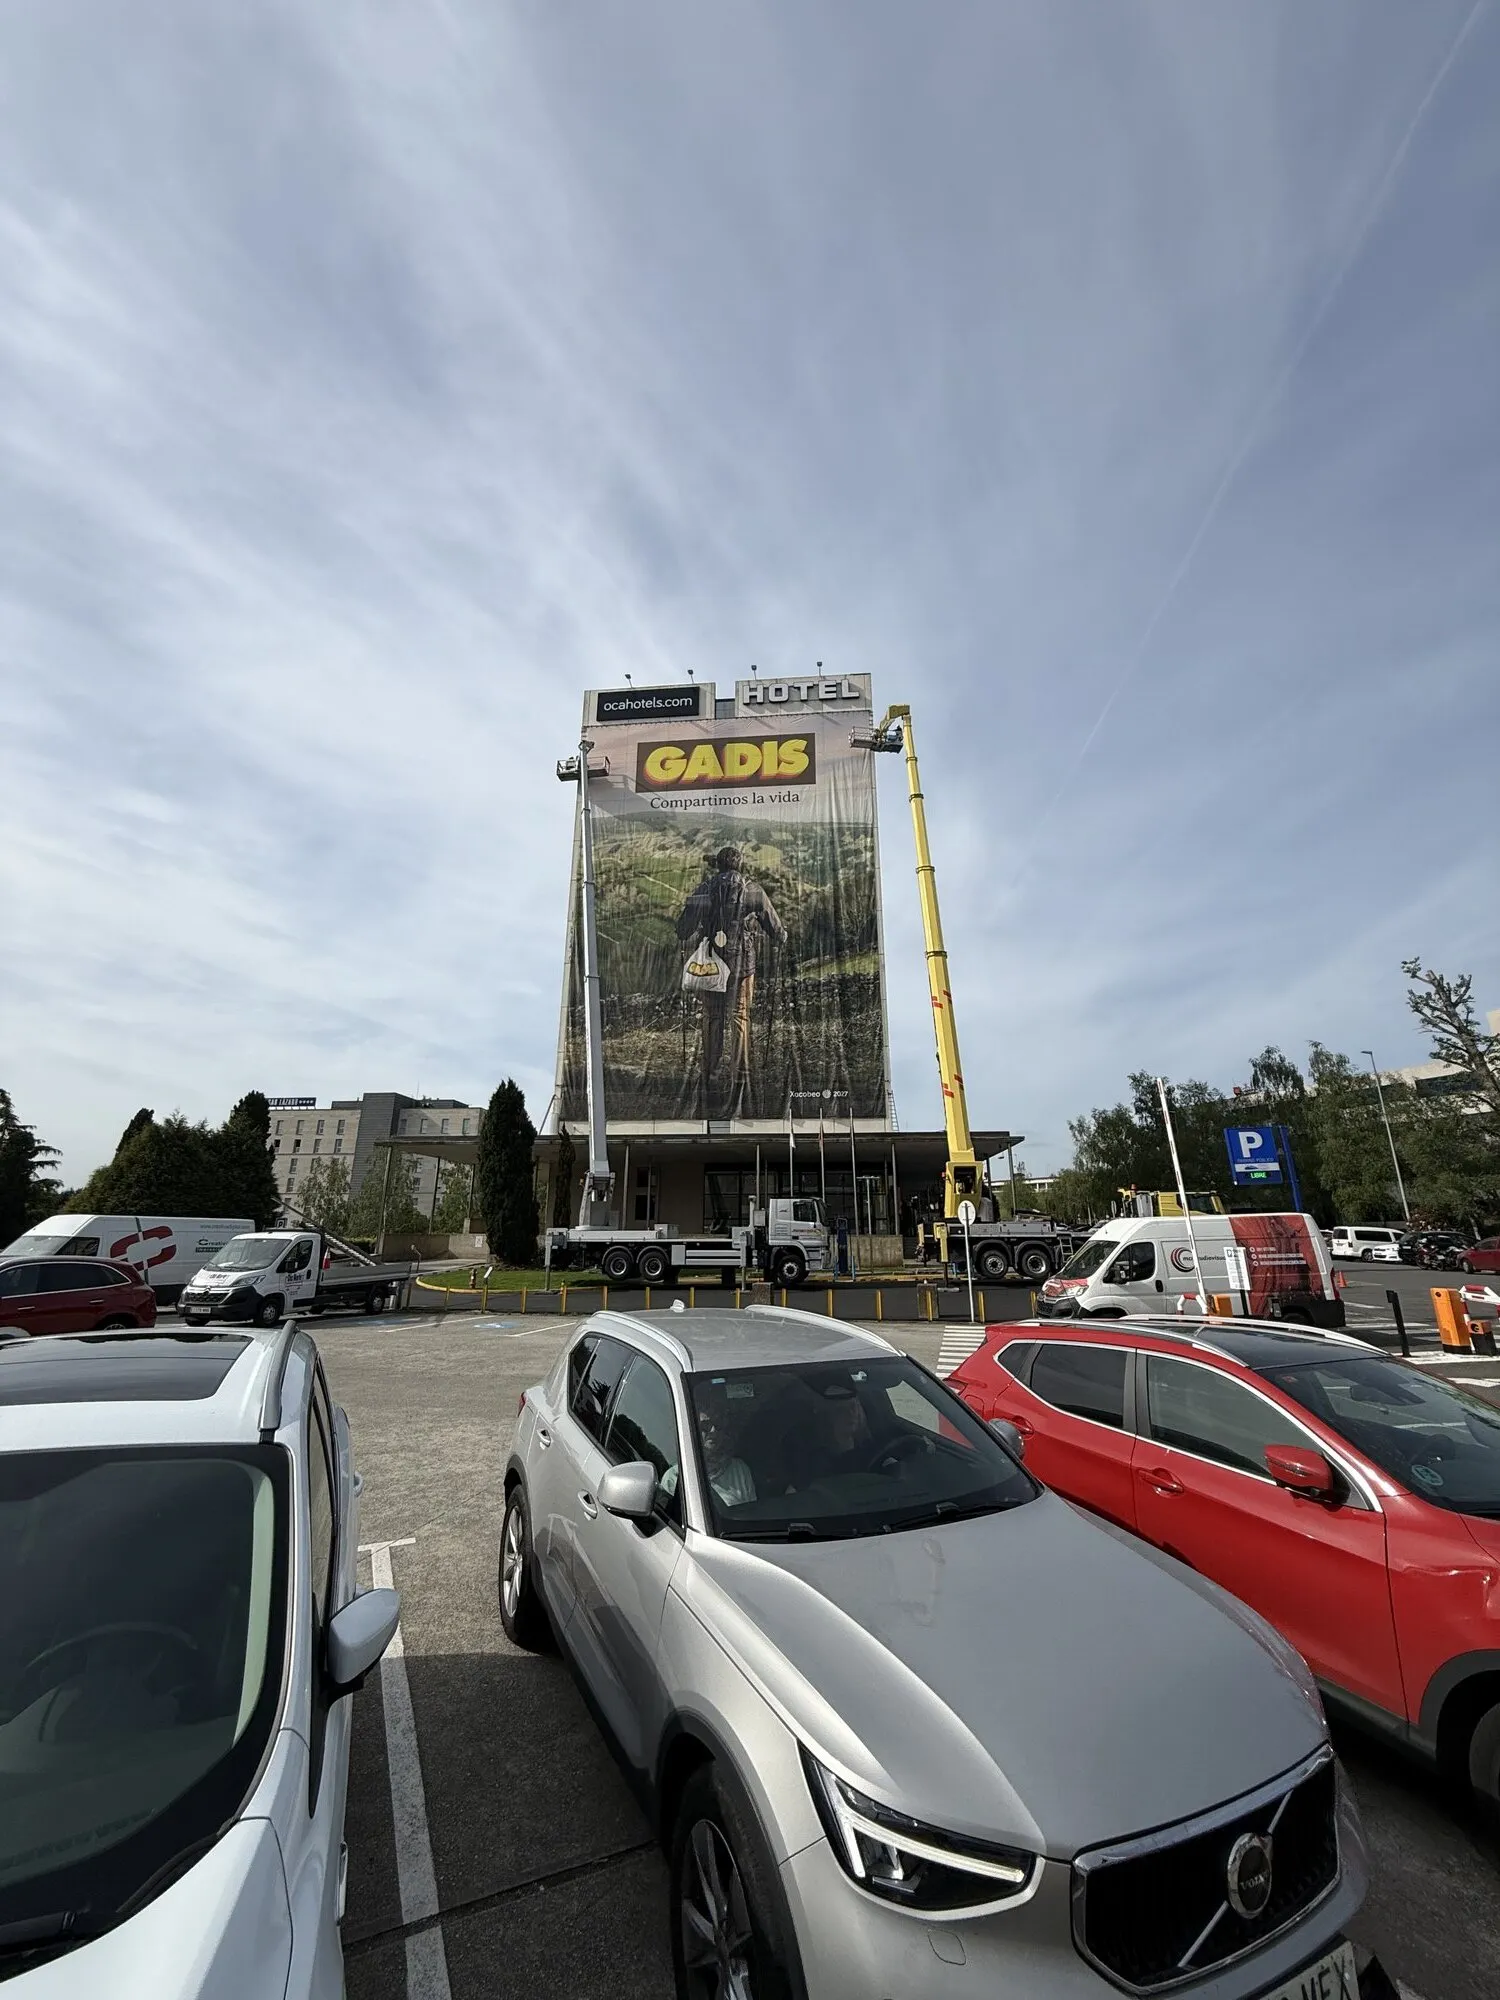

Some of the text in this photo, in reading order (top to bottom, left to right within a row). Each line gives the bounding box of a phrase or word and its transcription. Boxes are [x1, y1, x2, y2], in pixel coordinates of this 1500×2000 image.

[603, 695, 693, 712] ocahotels.com
[743, 679, 860, 705] HOTEL
[643, 738, 810, 785] GADIS
[650, 791, 801, 811] Compartimos la vida
[789, 1090, 821, 1098] Xacobeo
[1238, 1131, 1263, 1158] P
